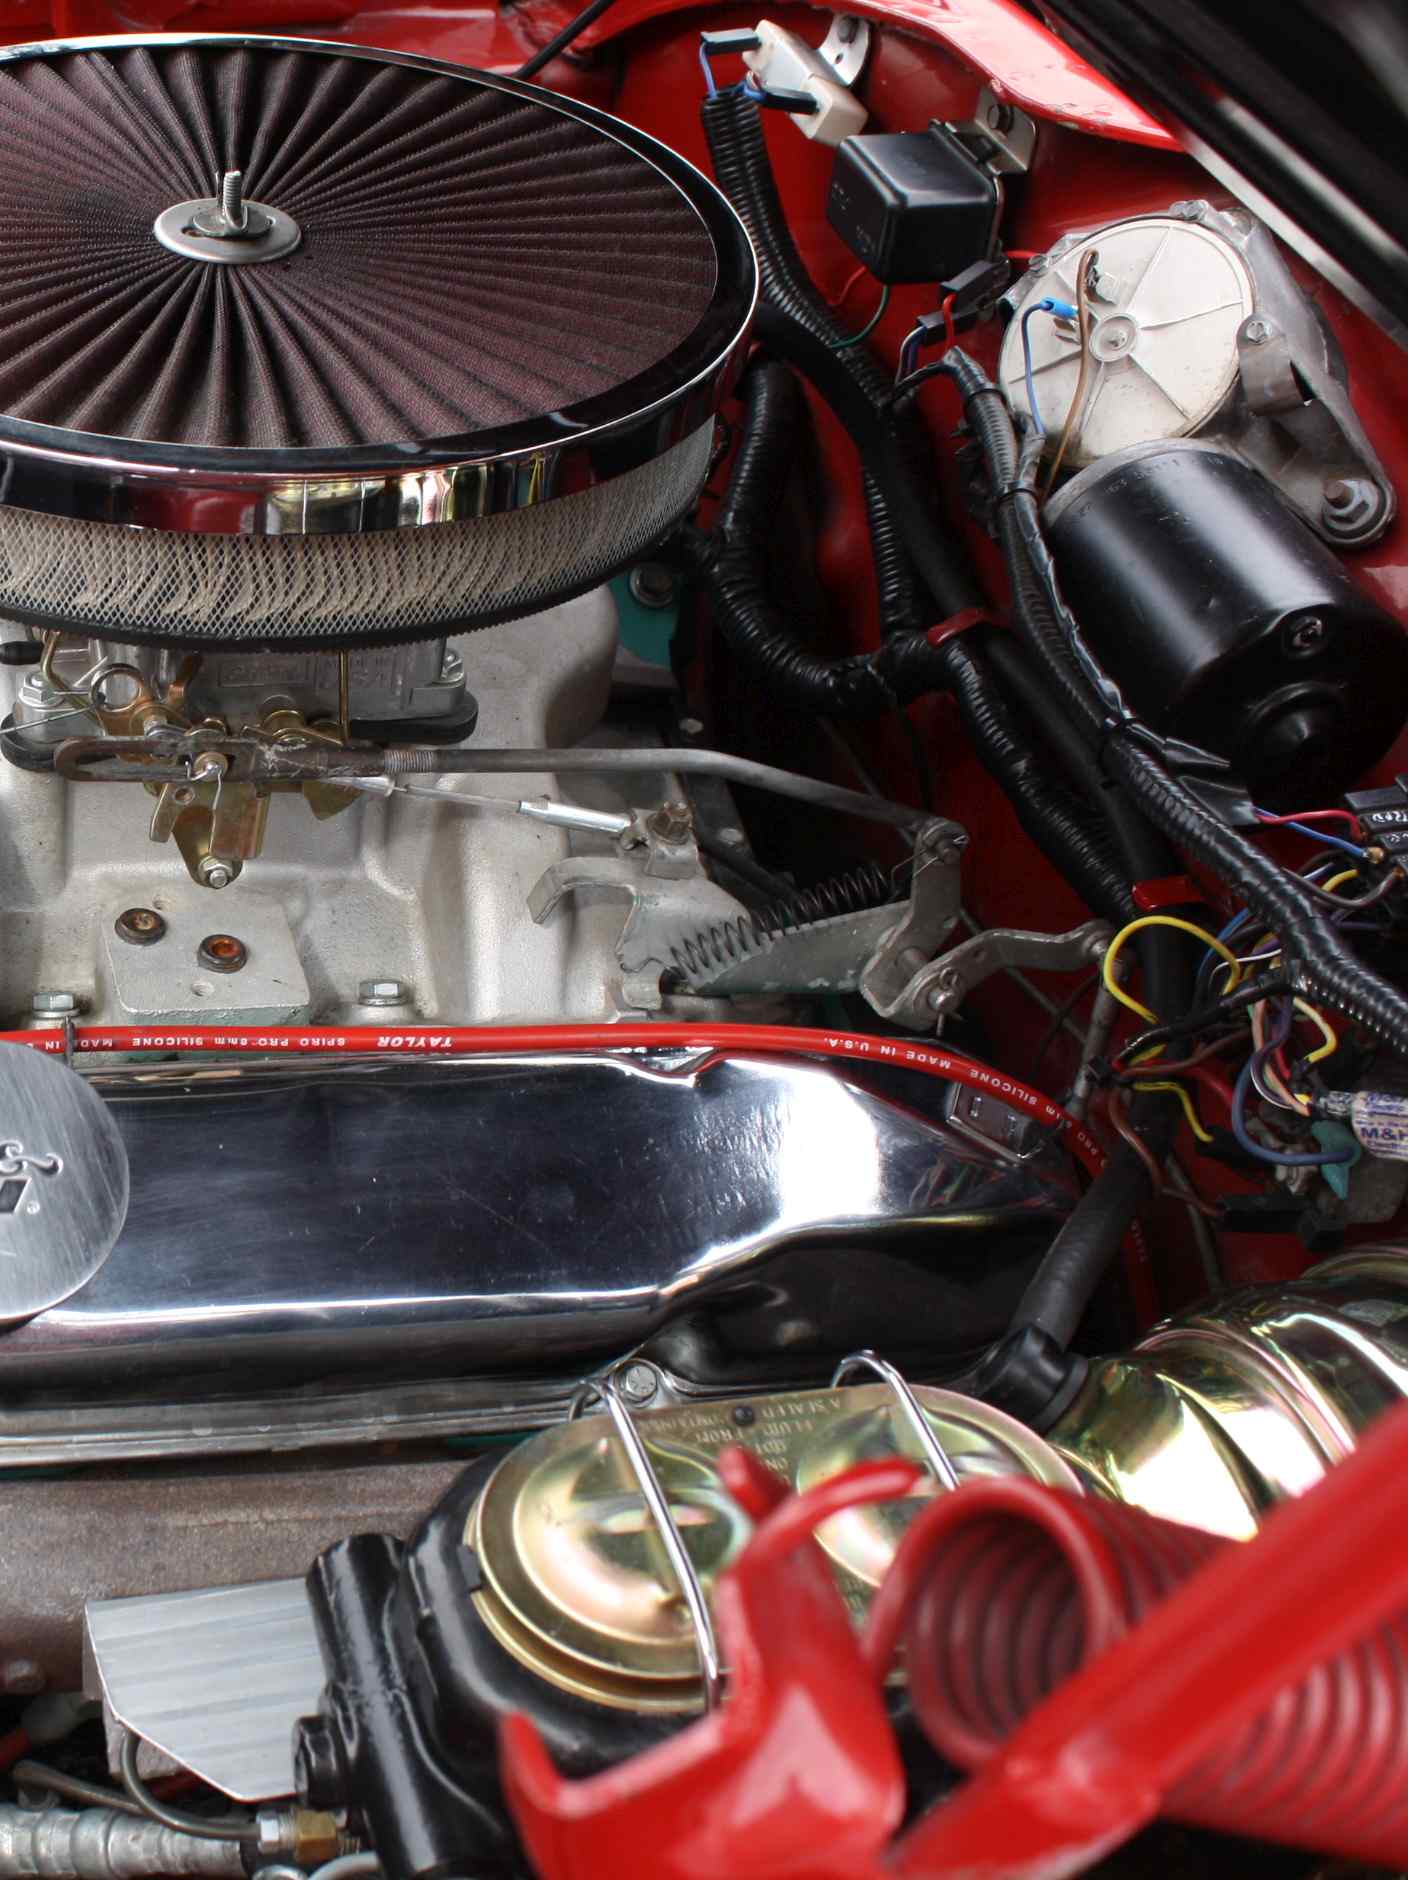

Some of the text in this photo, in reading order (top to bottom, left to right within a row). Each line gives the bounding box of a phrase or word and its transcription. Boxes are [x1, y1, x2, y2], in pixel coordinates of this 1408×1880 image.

[45, 1040, 60, 1050] IN
[76, 1039, 113, 1048] MAD
[132, 1037, 204, 1047] SILICONE
[299, 1037, 346, 1047] SPIRO
[376, 1036, 453, 1048] TAYLOR
[823, 1037, 870, 1052] U.S.A.
[880, 1045, 896, 1057] IN
[904, 1049, 952, 1070] MADE
[968, 1068, 1038, 1106] SILICONE
